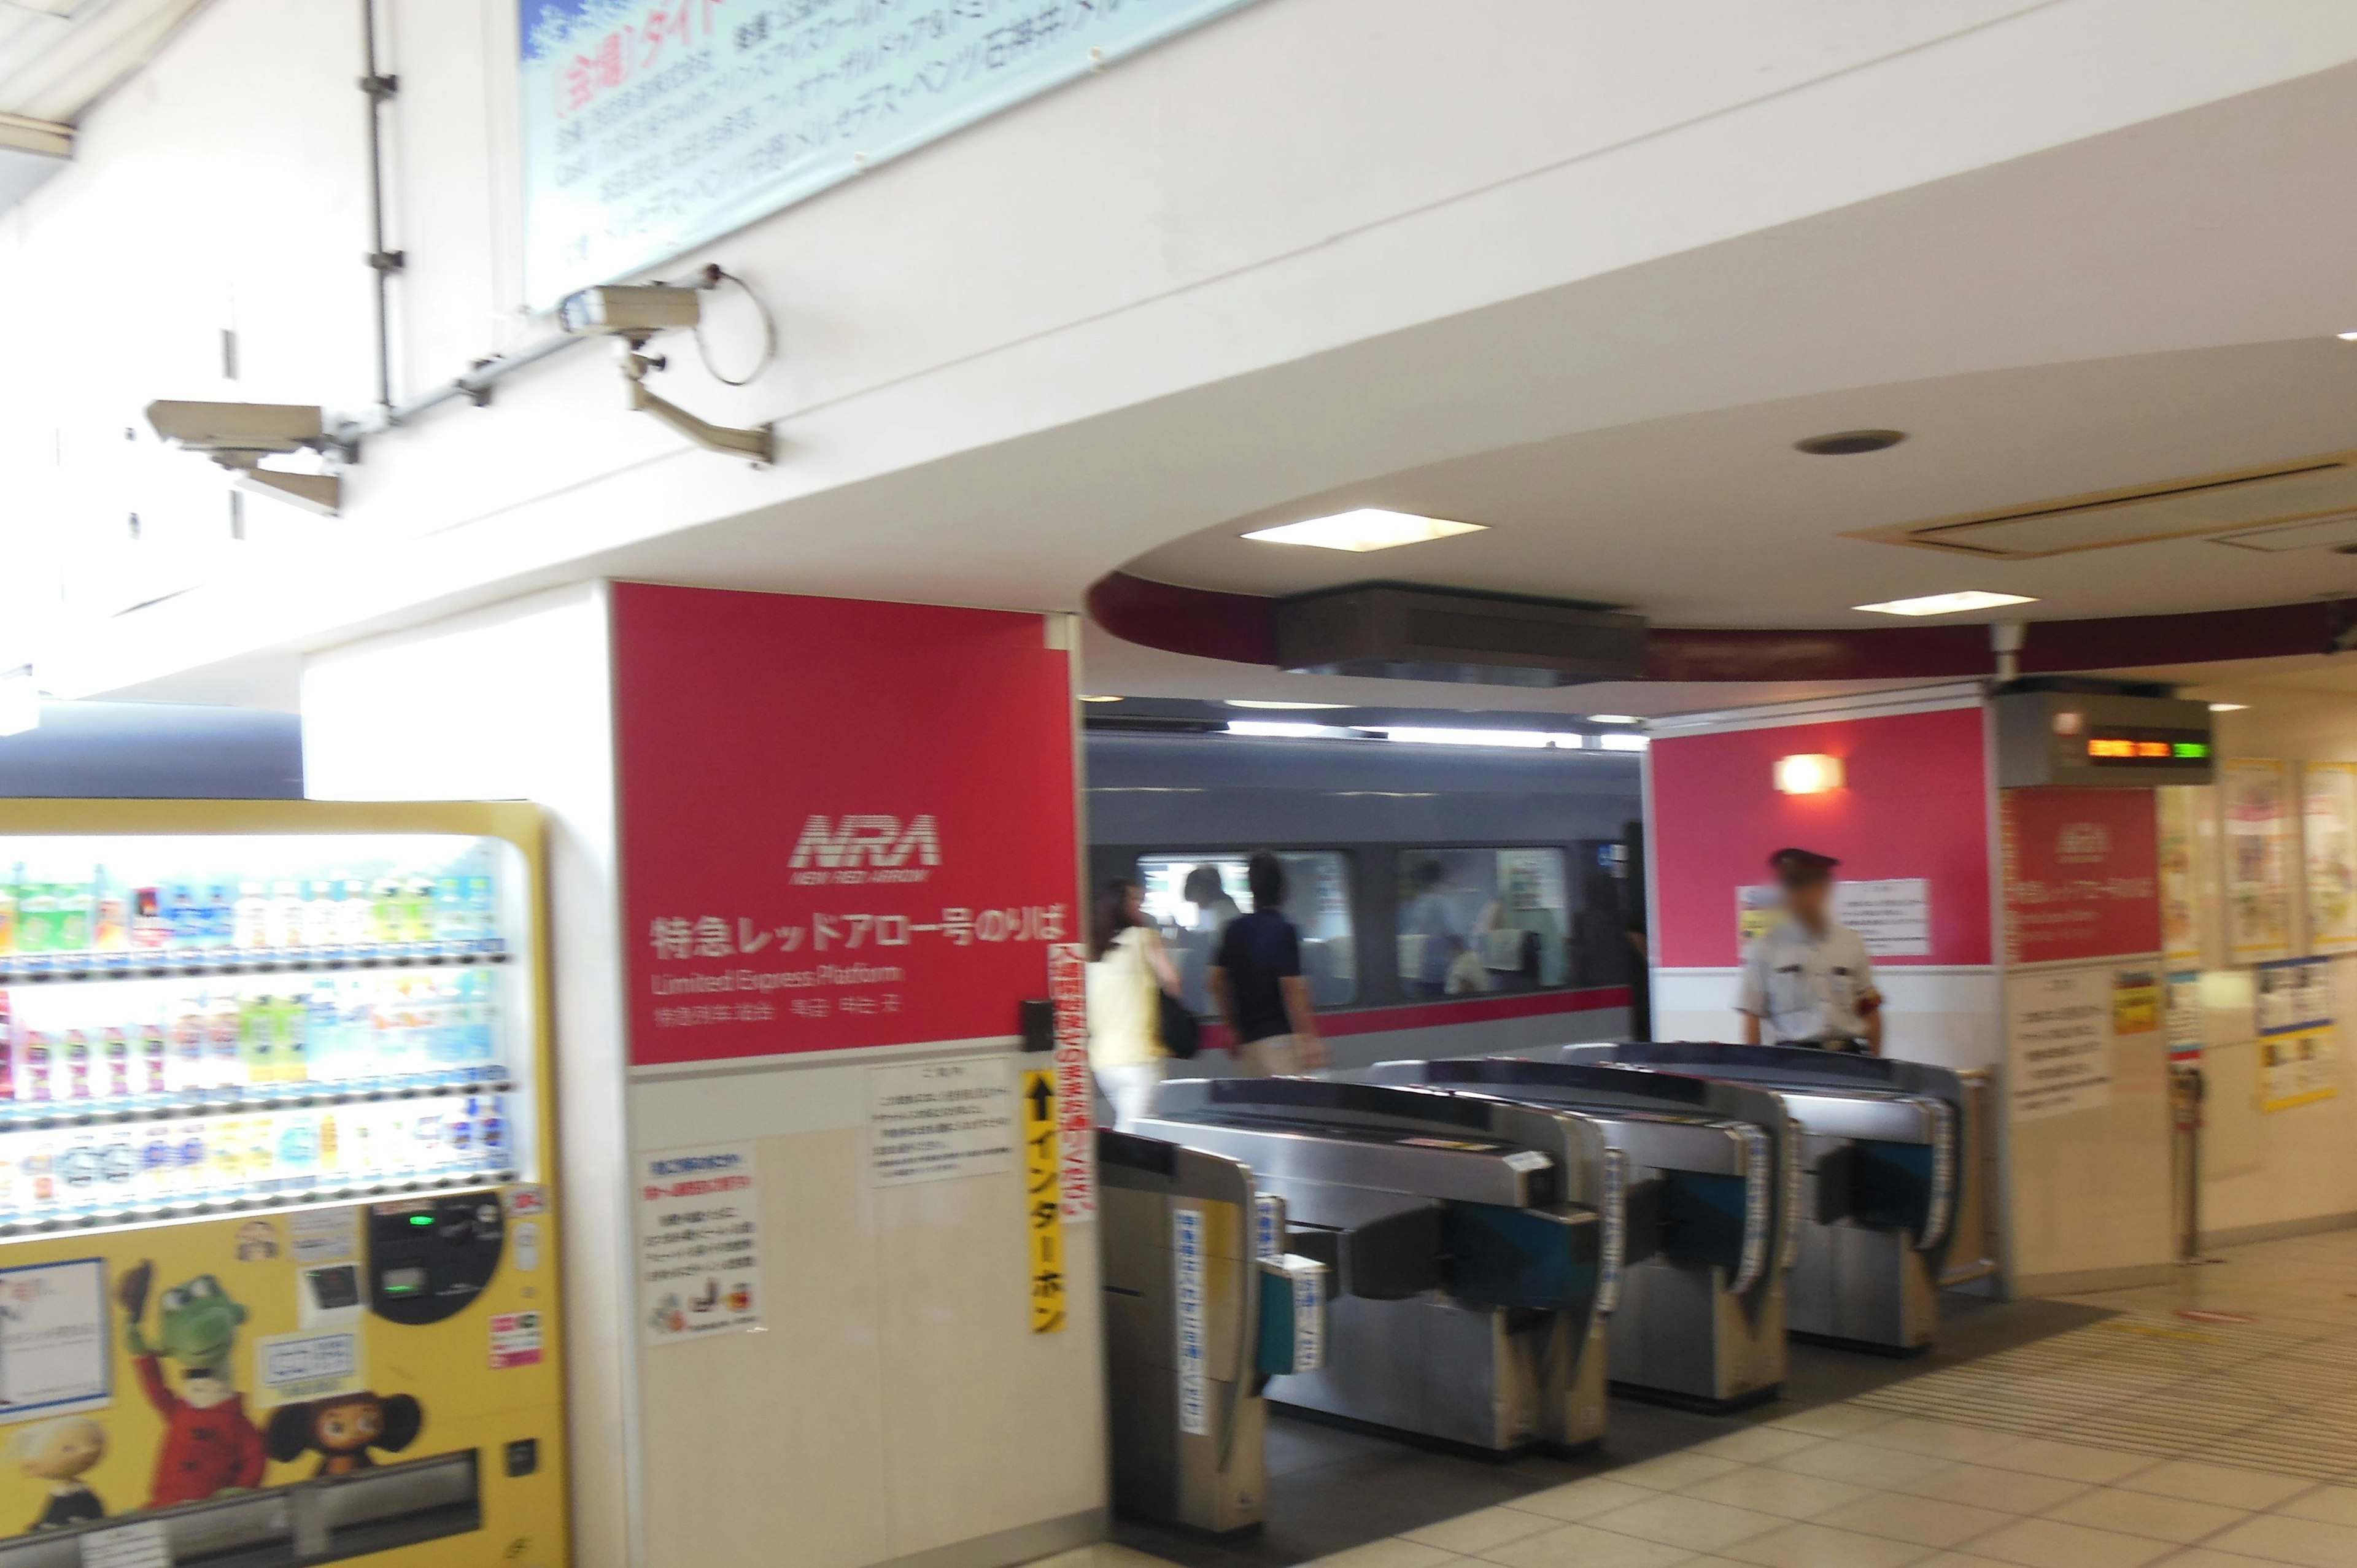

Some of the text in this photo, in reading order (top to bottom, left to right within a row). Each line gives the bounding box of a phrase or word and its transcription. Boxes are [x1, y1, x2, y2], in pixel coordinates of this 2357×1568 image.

[786, 815, 943, 868] NRA
[650, 904, 1067, 959] 特急レッドアロー号のりば
[651, 962, 906, 995] Limited Express Platform
[1029, 1130, 1066, 1333] インターホン
